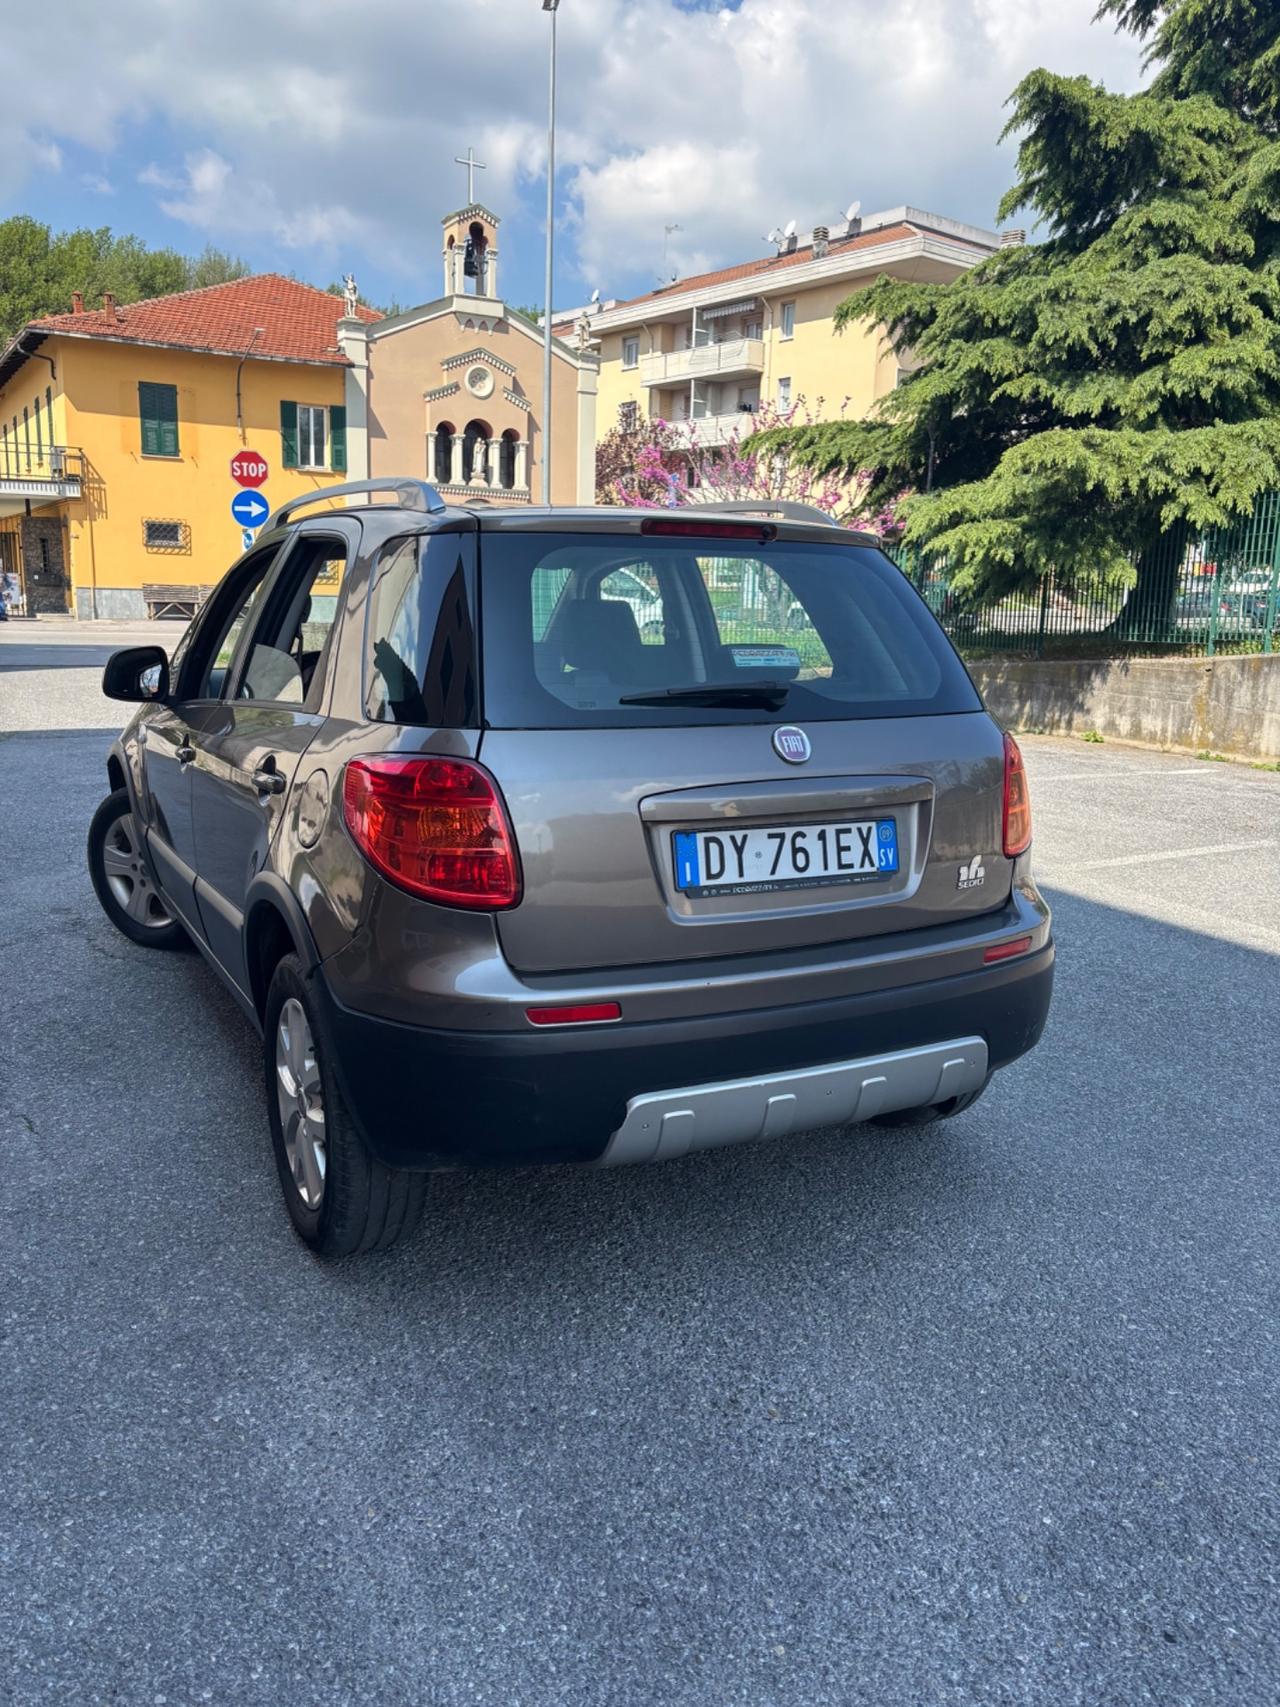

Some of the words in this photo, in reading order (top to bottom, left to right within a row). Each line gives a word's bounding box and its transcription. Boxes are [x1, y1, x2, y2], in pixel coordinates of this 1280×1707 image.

[232, 461, 267, 478] STOP
[781, 735, 804, 753] FIAT
[703, 833, 749, 881] DY
[767, 826, 876, 876] 761EX
[880, 847, 894, 867] SV
[685, 862, 691, 882] I
